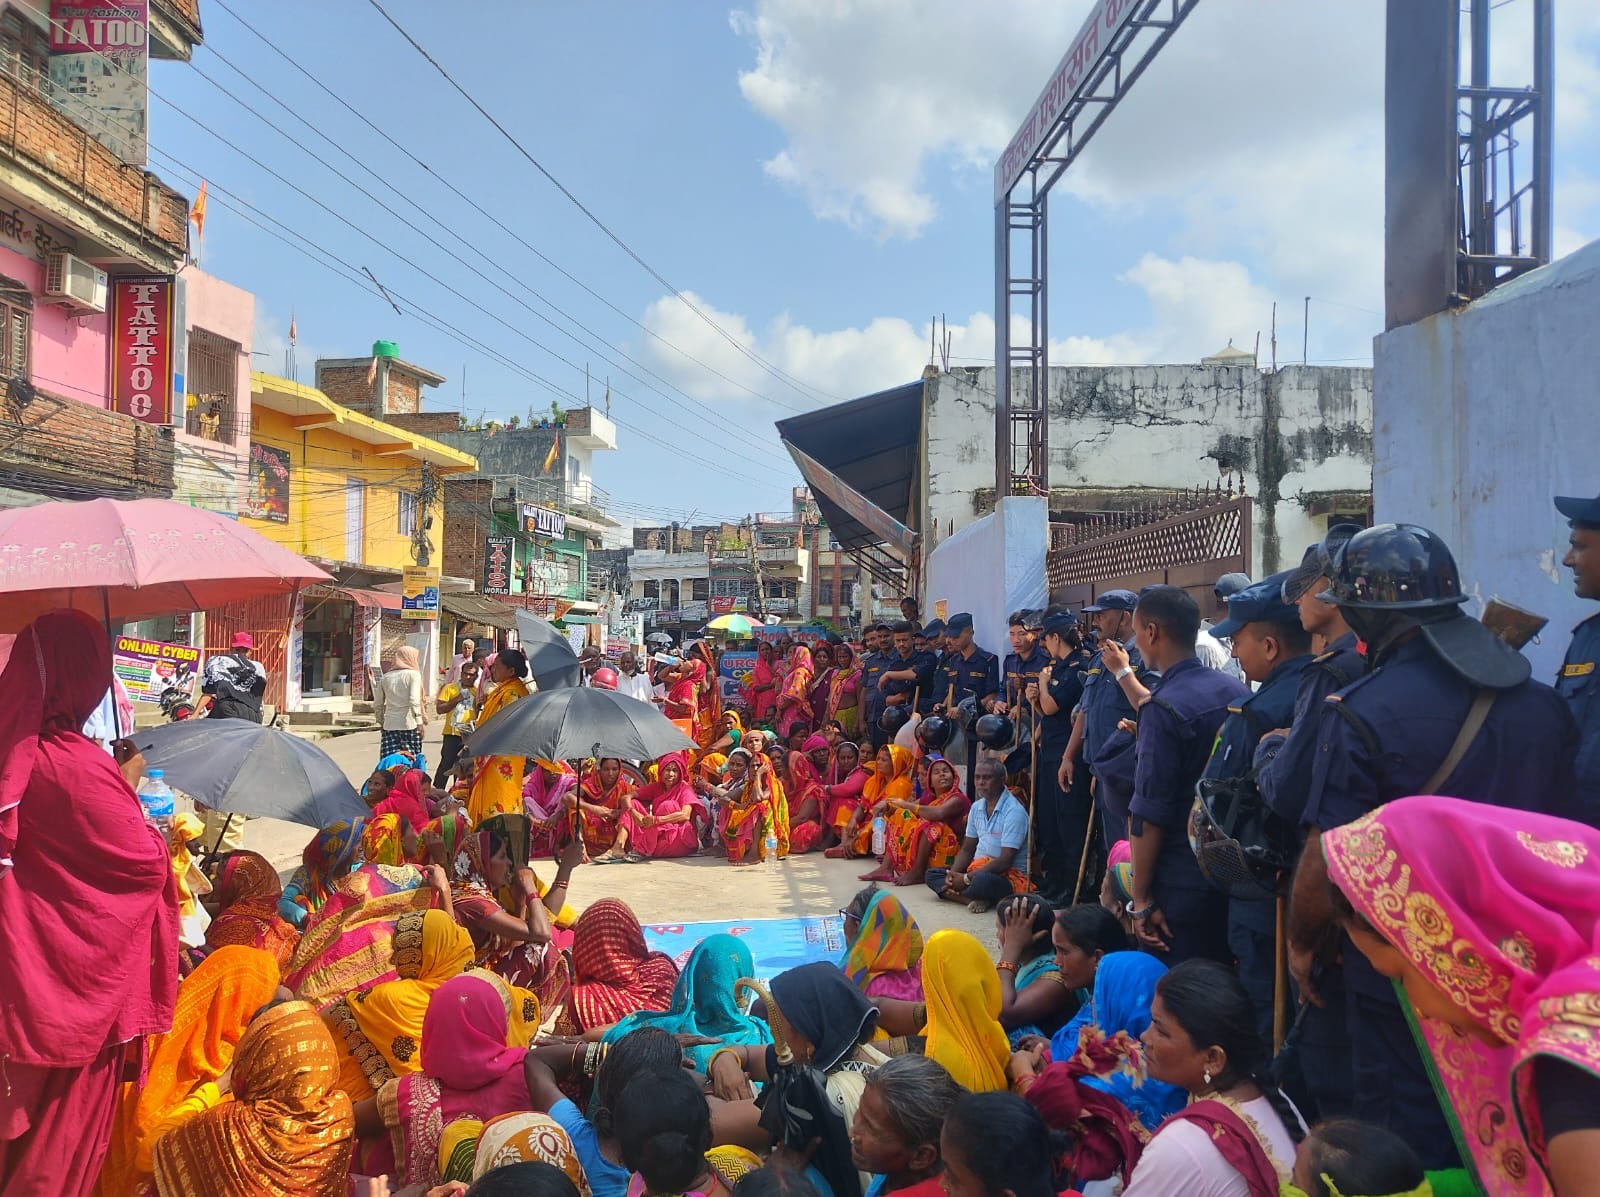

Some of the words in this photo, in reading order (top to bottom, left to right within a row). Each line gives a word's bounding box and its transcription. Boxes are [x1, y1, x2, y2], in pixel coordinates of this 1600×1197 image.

[91, 6, 140, 18] Fashion
[52, 19, 145, 47] TATOO
[1040, 11, 1102, 134] प्रशासन
[128, 285, 160, 418] TATTOO
[538, 509, 565, 535] TATTOO
[488, 544, 506, 588] TATTOO
[791, 630, 818, 642] Face
[118, 639, 161, 656] ONLINE
[162, 645, 199, 662] CYBER
[723, 658, 757, 669] URG
